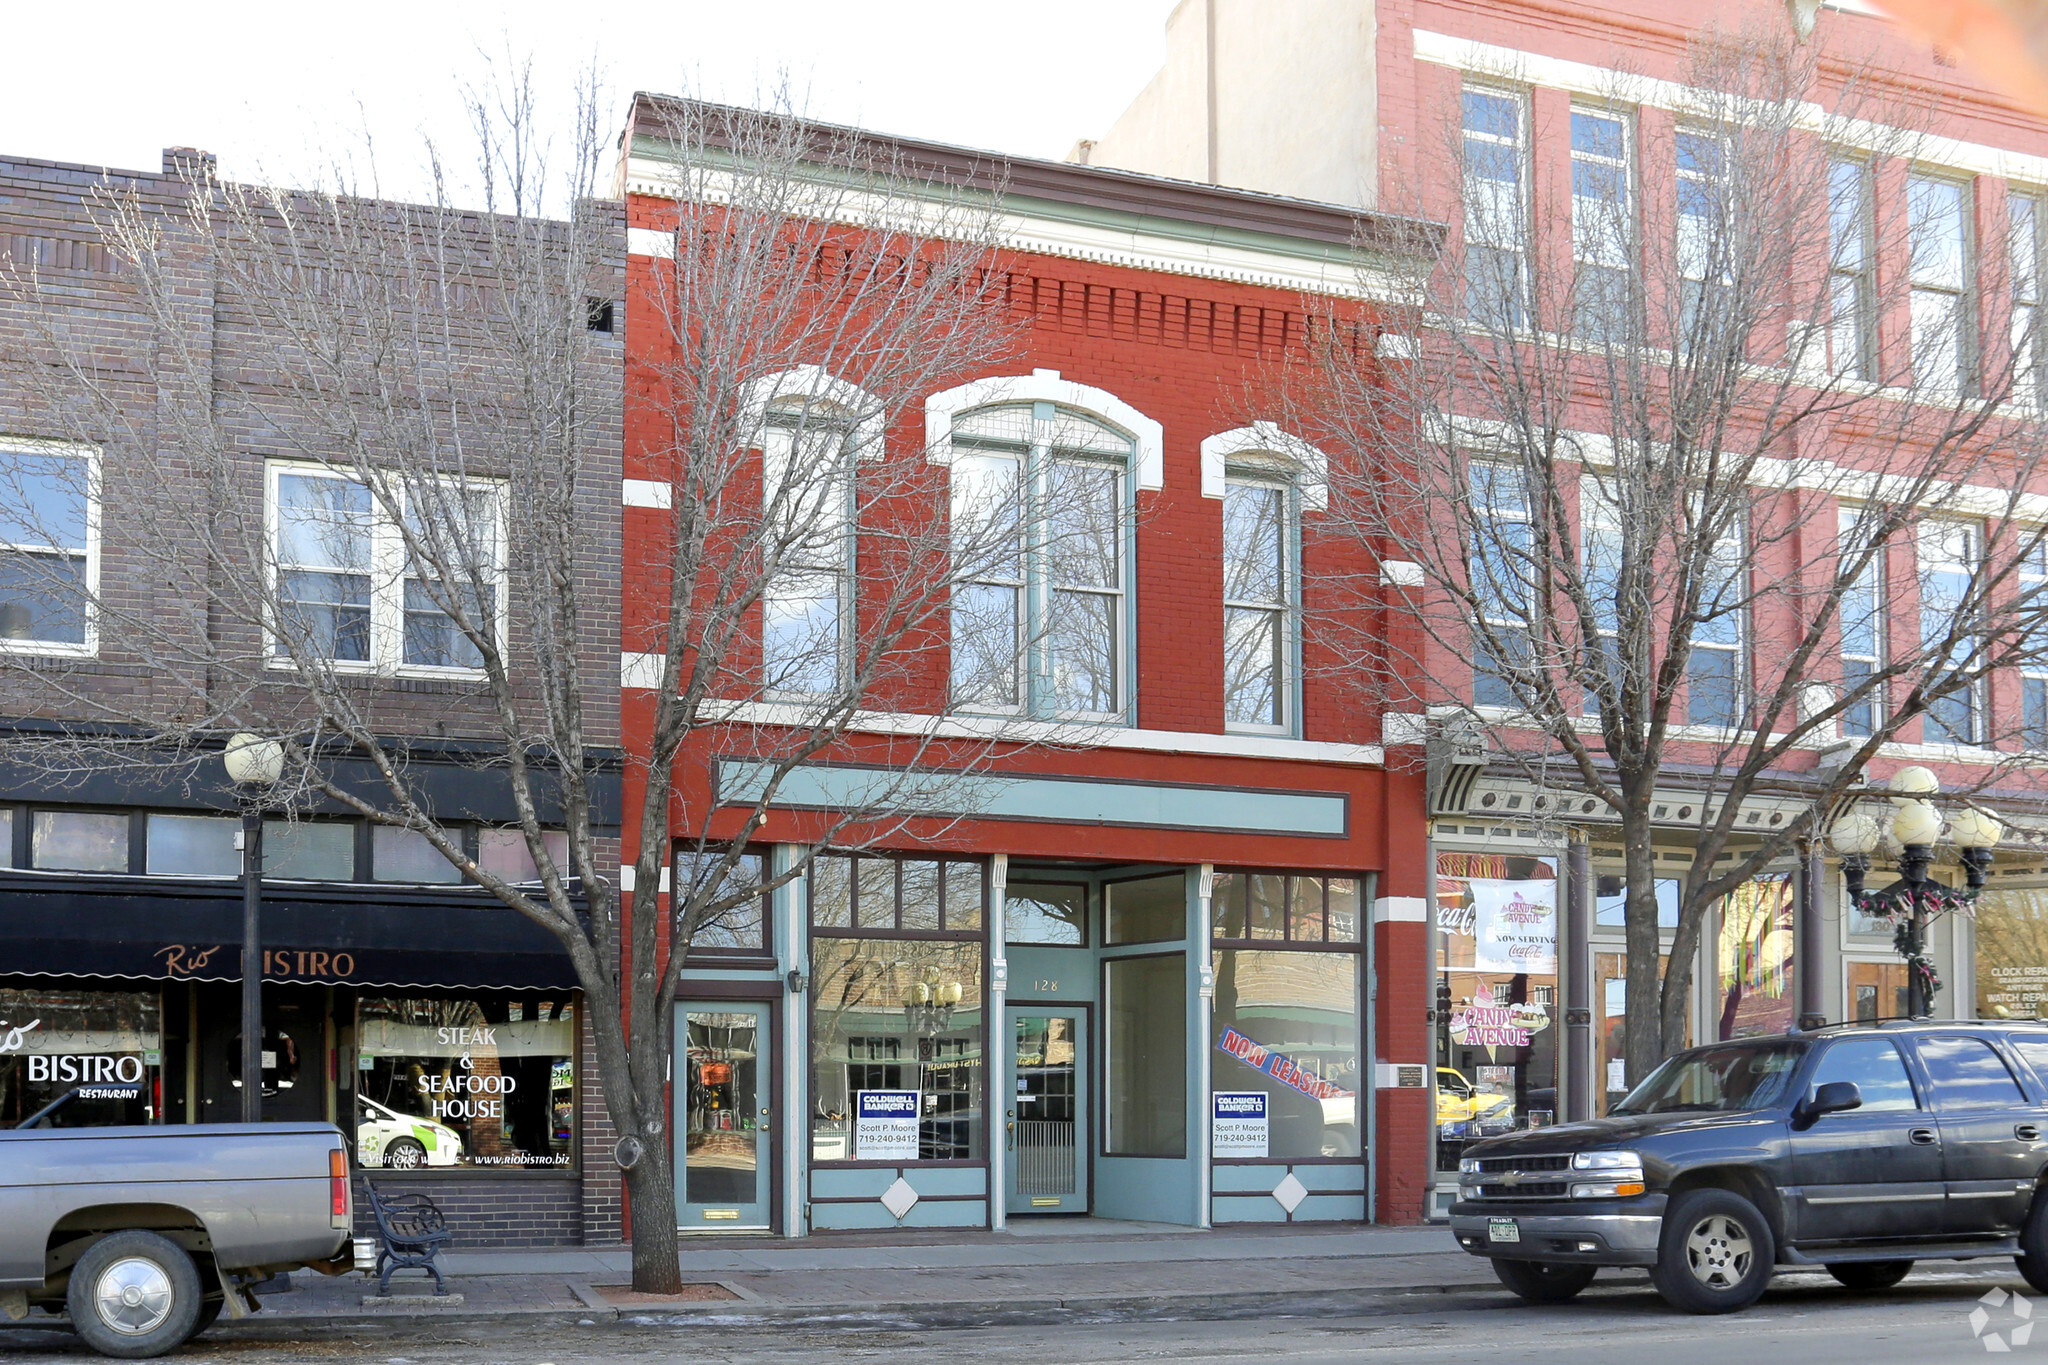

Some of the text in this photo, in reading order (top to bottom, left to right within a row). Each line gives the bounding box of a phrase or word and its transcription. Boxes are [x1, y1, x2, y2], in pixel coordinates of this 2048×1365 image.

[1508, 902, 1535, 913] CANDY
[1508, 913, 1541, 924] AVENUE
[1496, 934, 1556, 944] NOW SERVING
[153, 944, 355, 977] Rio ISTRO
[1991, 967, 2023, 977] CLOCK
[1034, 979, 1058, 991] 128
[1986, 994, 2020, 1003] WATCH
[1464, 1006, 1518, 1026] CANDY
[437, 1026, 497, 1045] STEAK
[1463, 1027, 1530, 1046] AVENUE
[1222, 1030, 1269, 1068] NOW
[459, 1051, 475, 1070] &
[28, 1055, 143, 1083] BISTRO
[418, 1075, 516, 1094] SEAFOOD
[79, 1089, 138, 1099] RESTAURANT
[432, 1099, 501, 1118] HOUSE
[860, 1124, 881, 1132] Scott
[1215, 1124, 1234, 1132] Scott
[859, 1134, 917, 1143] 719-240-9412
[1214, 1134, 1267, 1142] 719-240-9412
